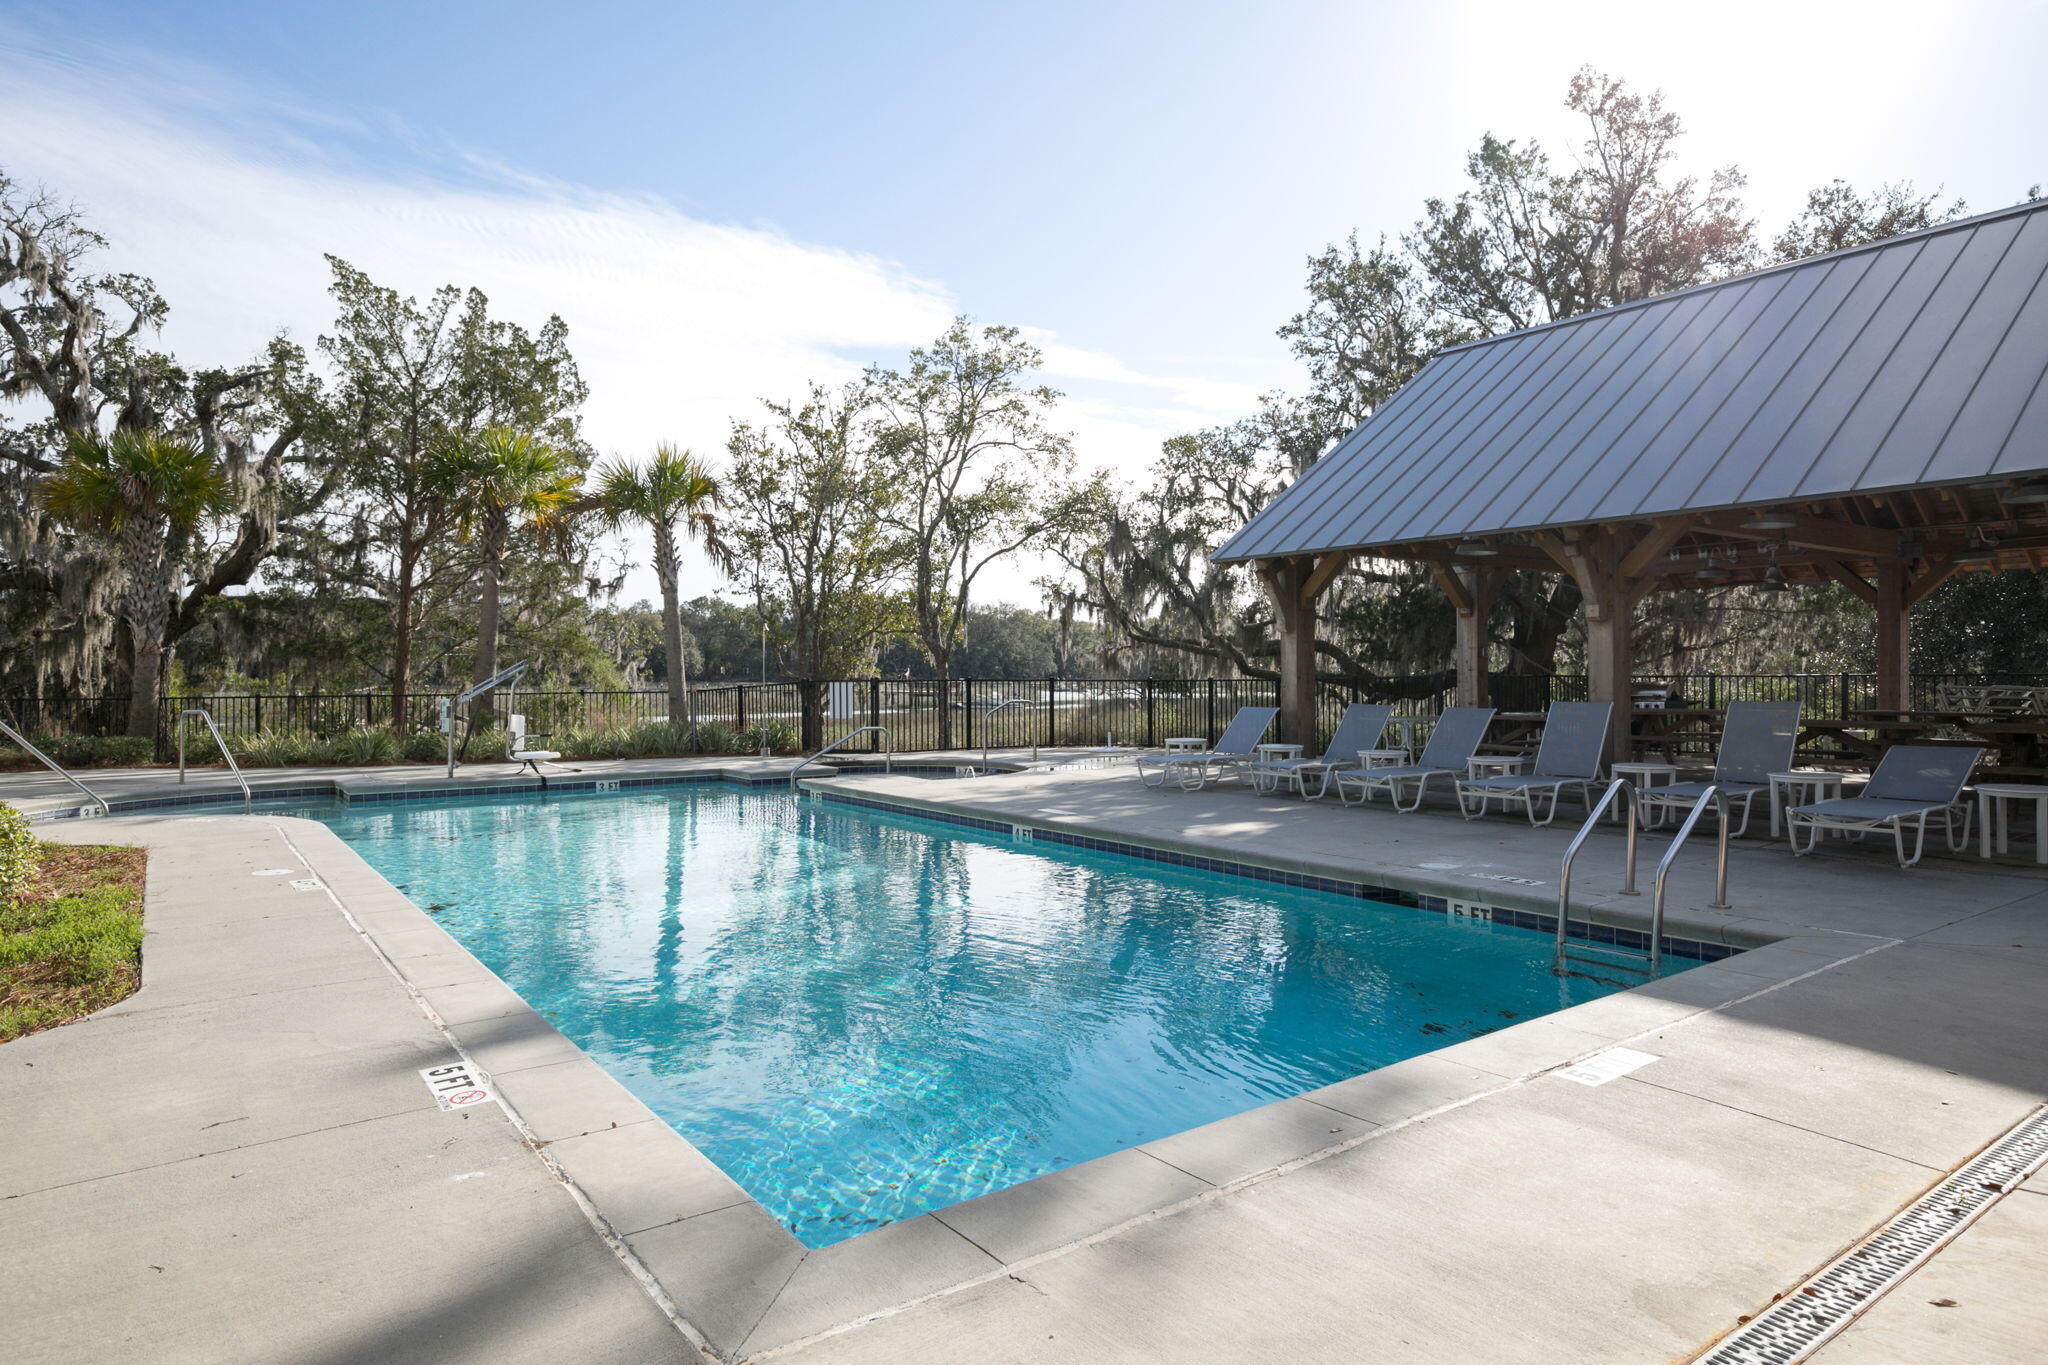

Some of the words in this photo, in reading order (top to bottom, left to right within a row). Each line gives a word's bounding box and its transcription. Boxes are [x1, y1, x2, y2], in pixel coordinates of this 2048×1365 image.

[1470, 906, 1490, 920] FT
[429, 1065, 465, 1077] 5
[1565, 1069, 1602, 1082] 5
[434, 1074, 475, 1092] FT
